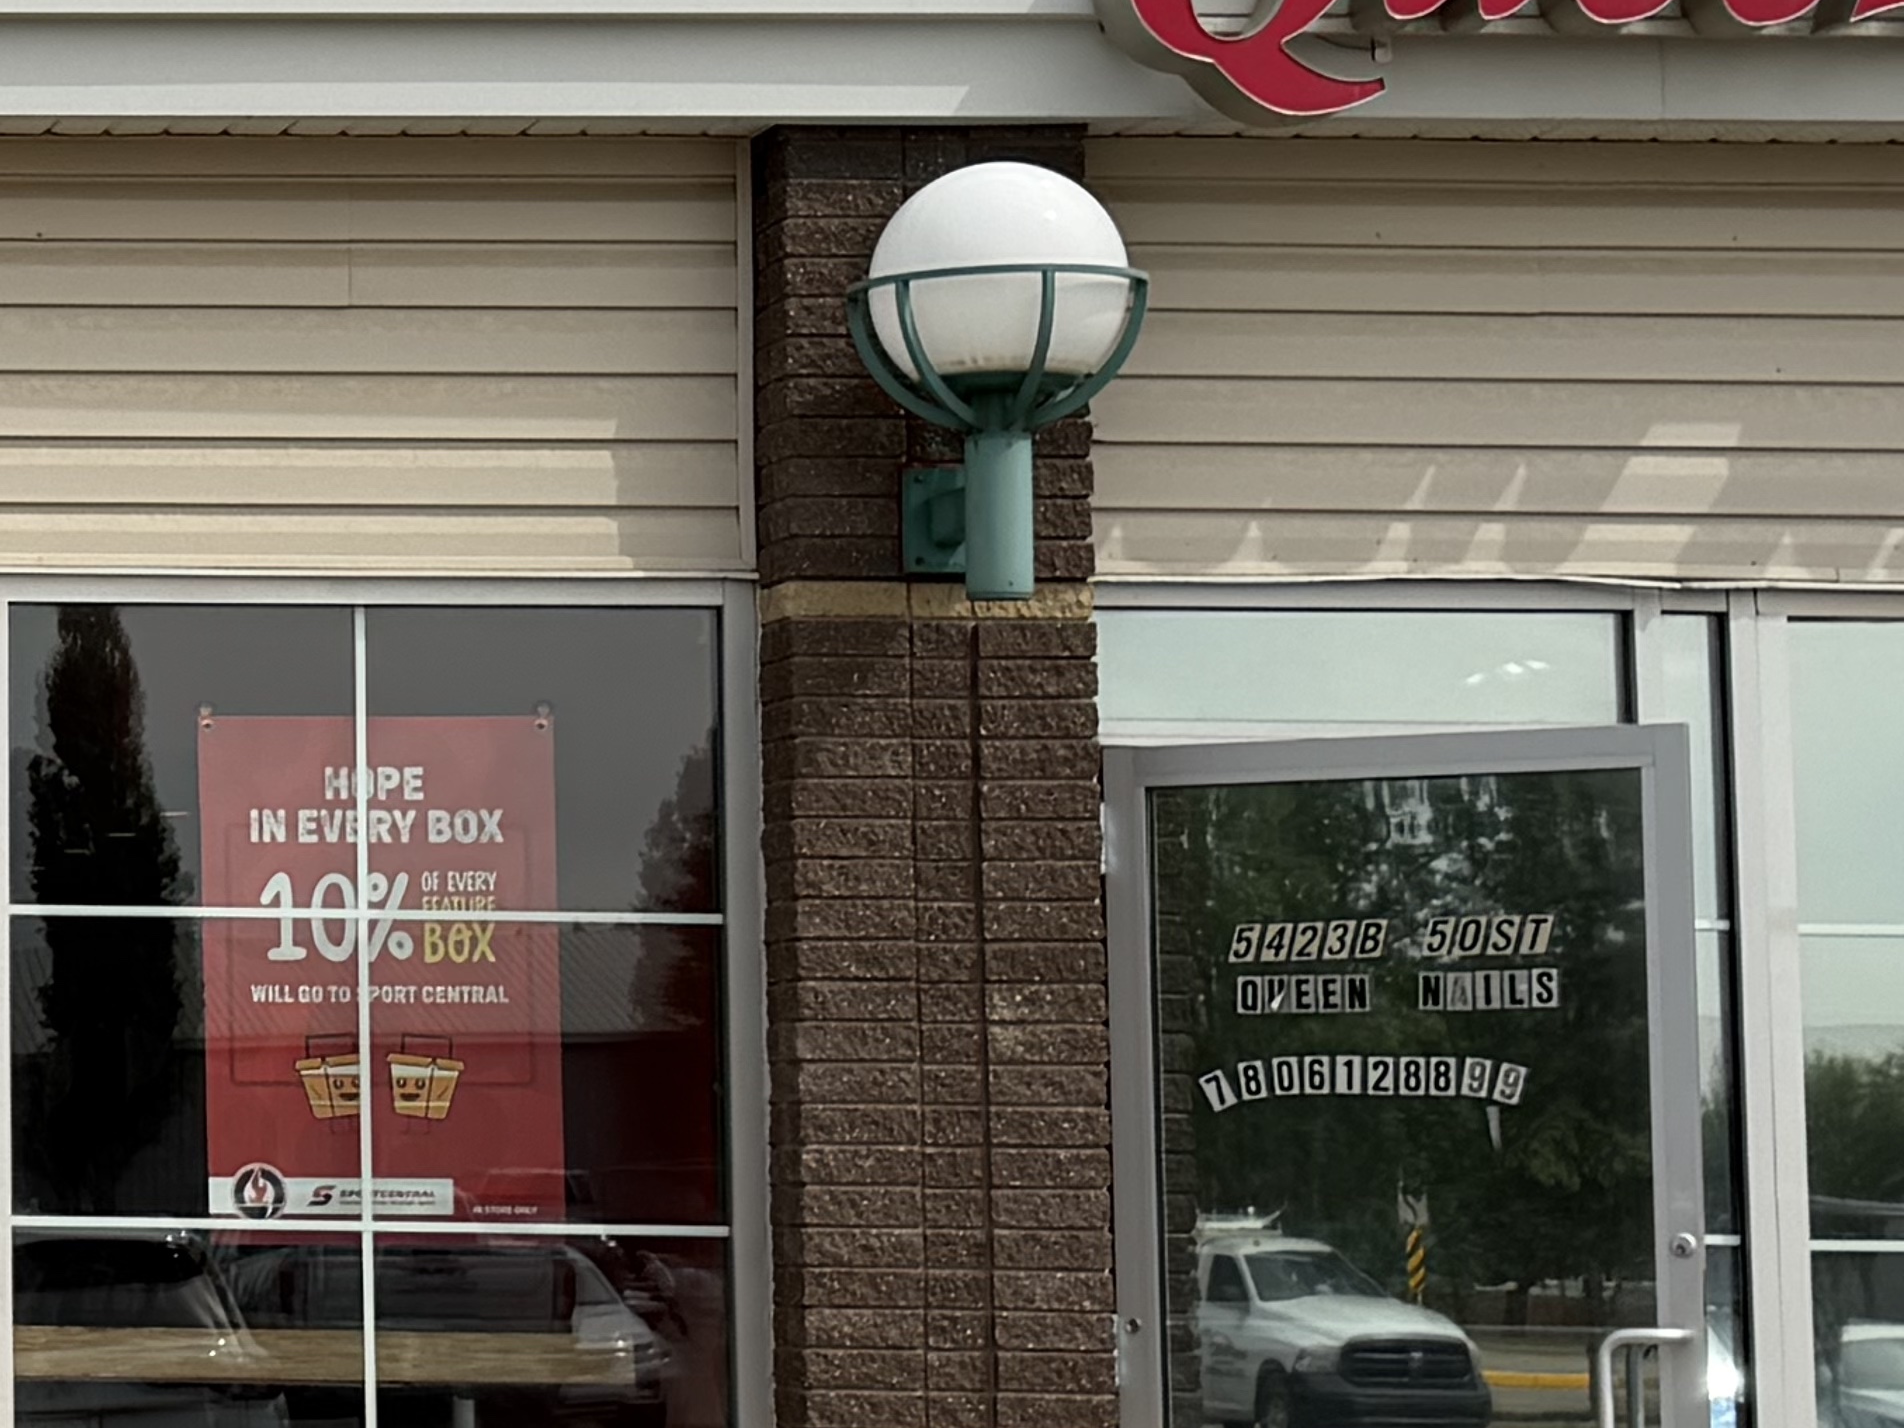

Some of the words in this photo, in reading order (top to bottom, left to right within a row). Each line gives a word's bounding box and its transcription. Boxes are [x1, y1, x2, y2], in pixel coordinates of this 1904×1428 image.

[250, 809, 286, 843] IN
[298, 809, 416, 843] EVERY
[428, 809, 504, 844] BOX
[421, 871, 439, 892] OF
[447, 871, 498, 892] EVERY
[260, 871, 414, 962] 10%
[424, 921, 496, 964] BOX
[1232, 920, 1384, 961] 5423B
[1426, 917, 1551, 956] 50ST
[251, 985, 293, 1003] WILL
[298, 985, 323, 1003] GO
[328, 985, 351, 1003] TO
[355, 985, 416, 1004] PORT
[421, 985, 509, 1004] CENTRAL
[1422, 970, 1556, 1008] NAILS
[1205, 1057, 1525, 1109] 7806128899
[340, 1189, 435, 1198] SPOTCENTRAL
